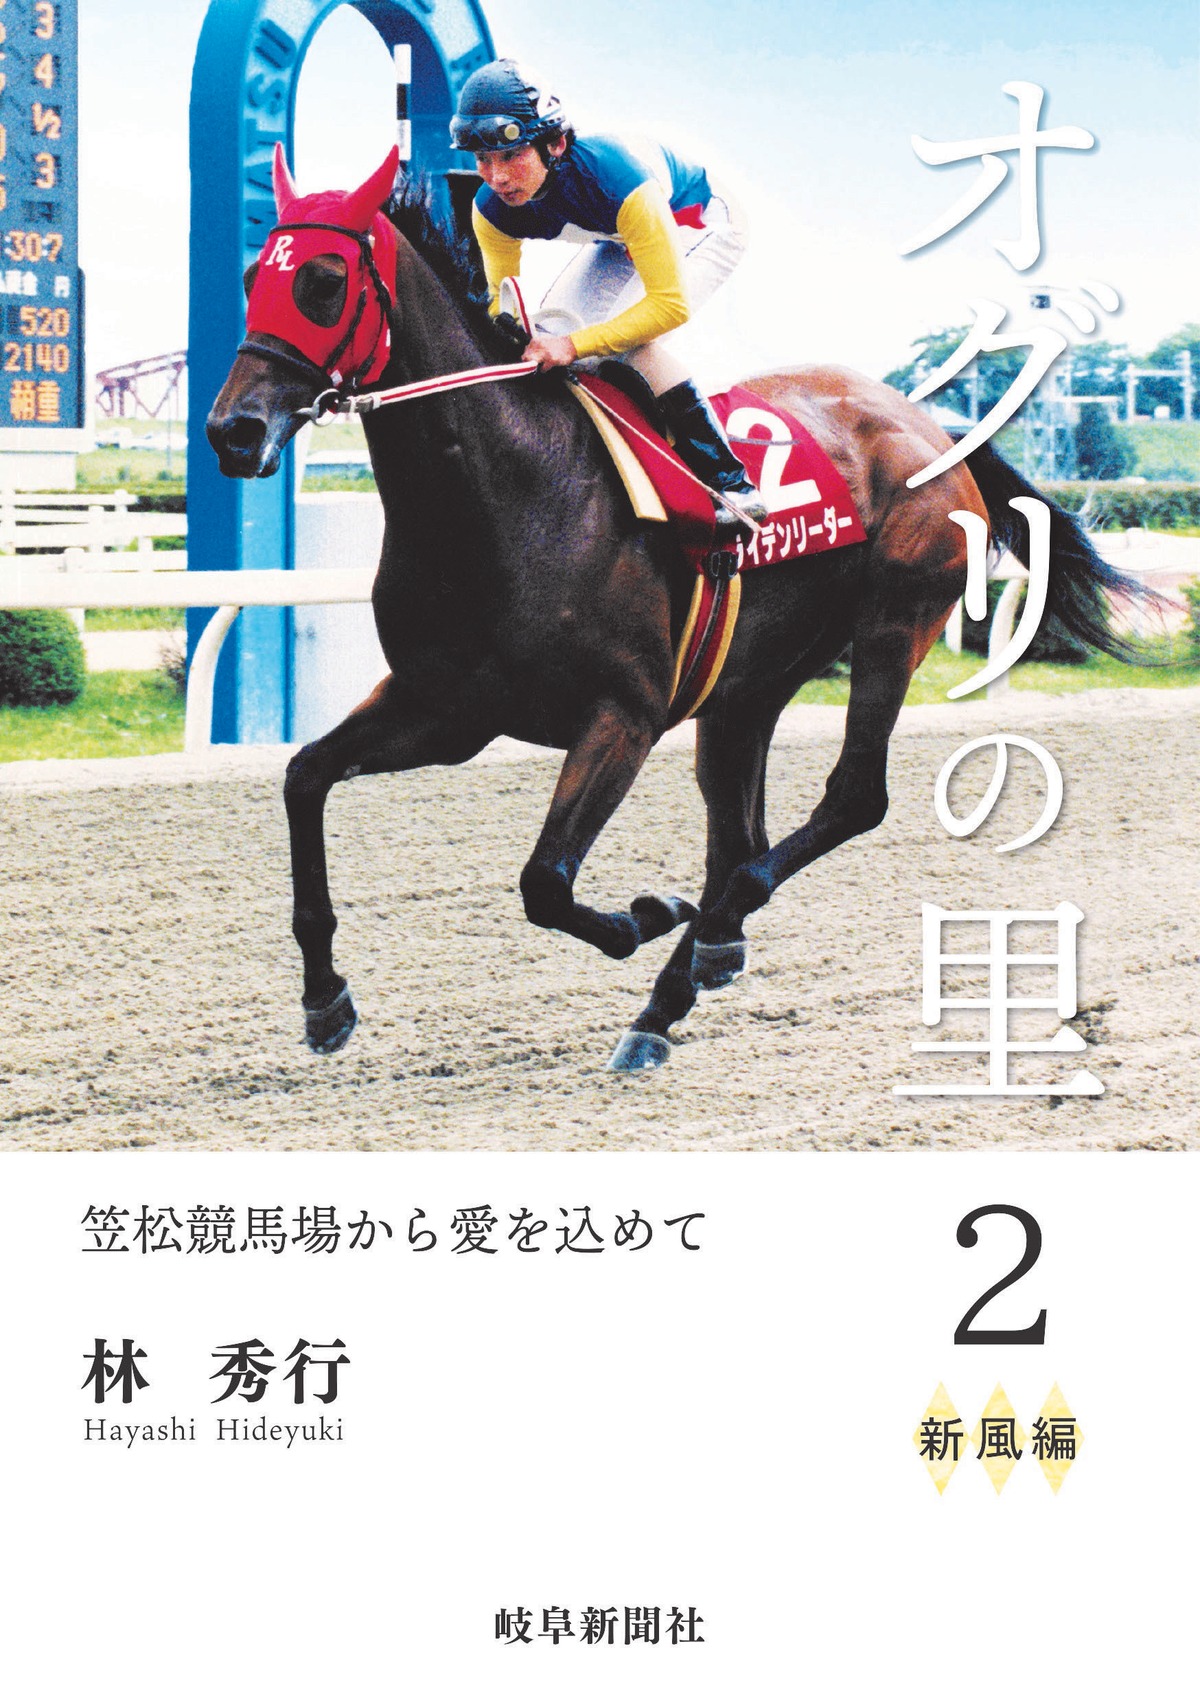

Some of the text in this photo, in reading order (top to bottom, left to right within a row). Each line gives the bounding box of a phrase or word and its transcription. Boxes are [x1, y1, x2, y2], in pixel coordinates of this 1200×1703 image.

[35, 2, 54, 39] 3
[34, 53, 53, 88] 4
[35, 152, 55, 189] 3
[20, 306, 69, 336] 520
[4, 342, 69, 372] 2140
[725, 407, 822, 514] 2
